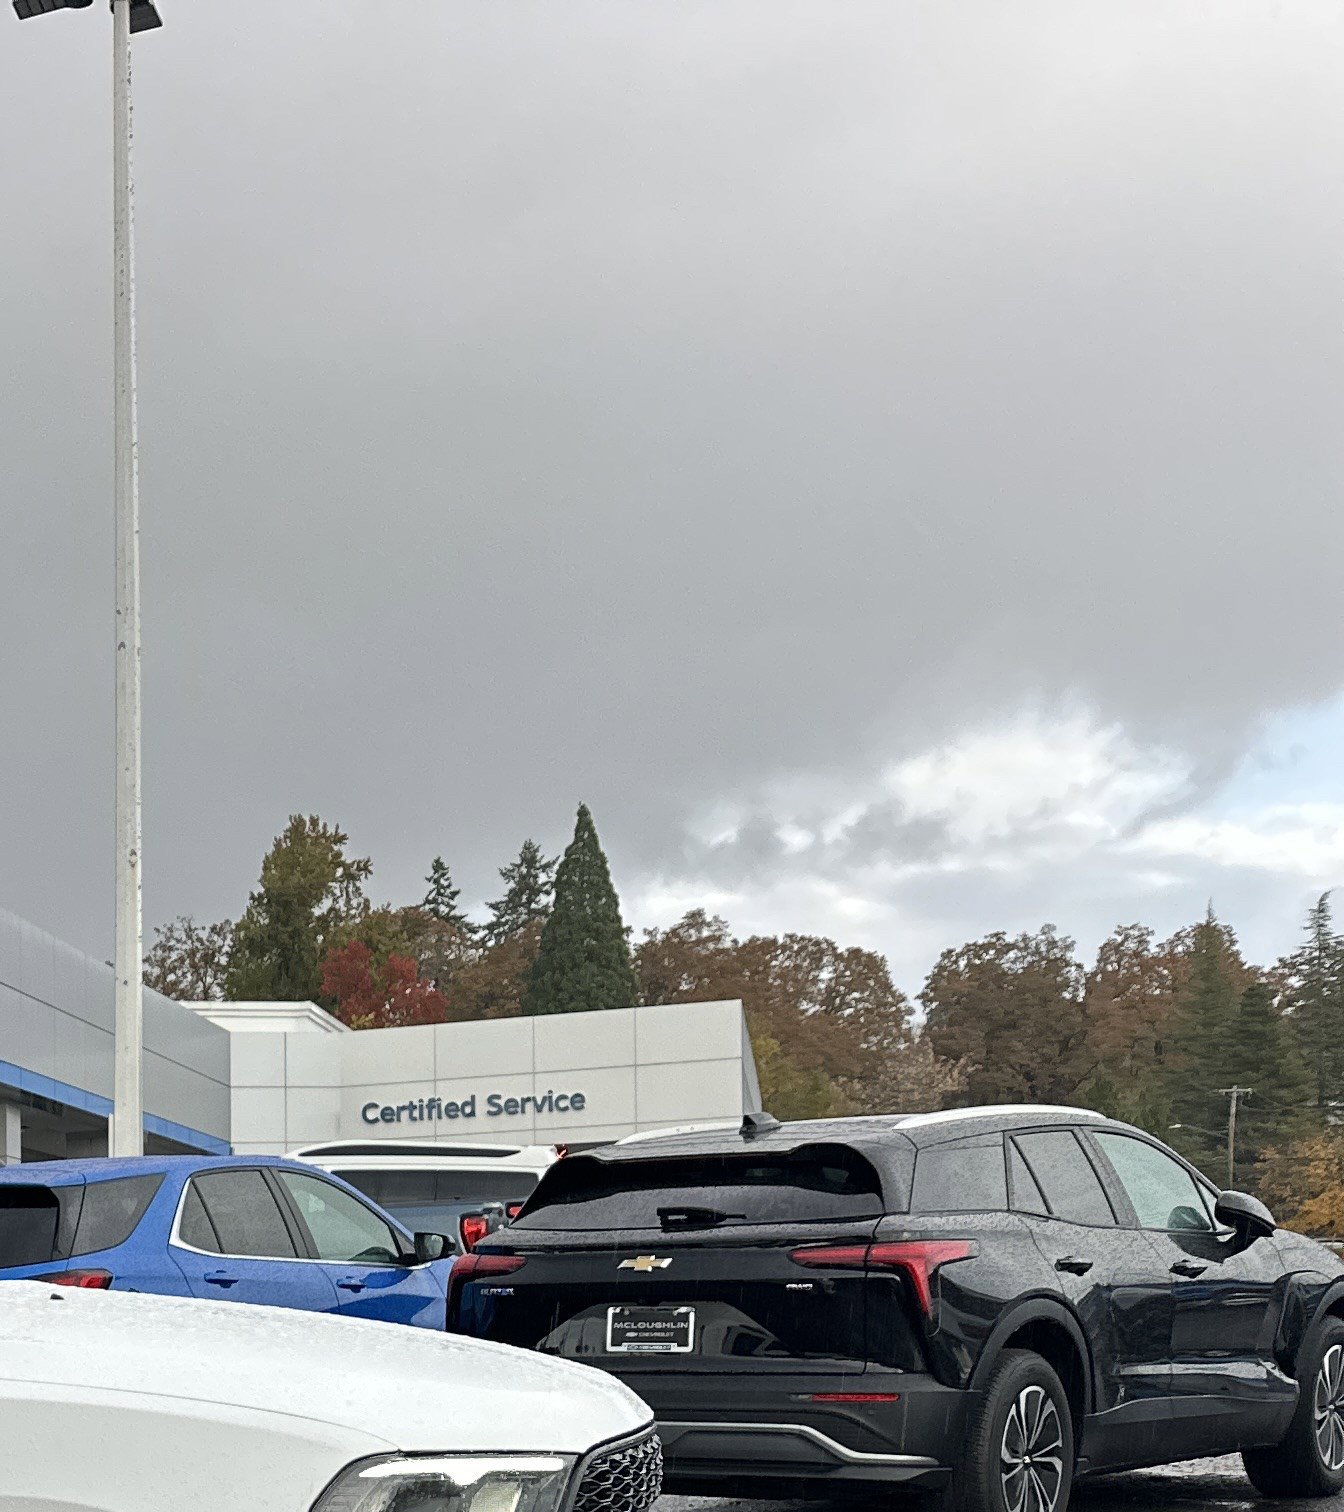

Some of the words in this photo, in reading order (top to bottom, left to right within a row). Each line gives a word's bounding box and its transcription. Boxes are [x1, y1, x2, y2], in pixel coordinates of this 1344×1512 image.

[361, 1094, 476, 1124] Certified
[486, 1089, 587, 1117] Service
[613, 1321, 688, 1329] MCLOUGHLIN
